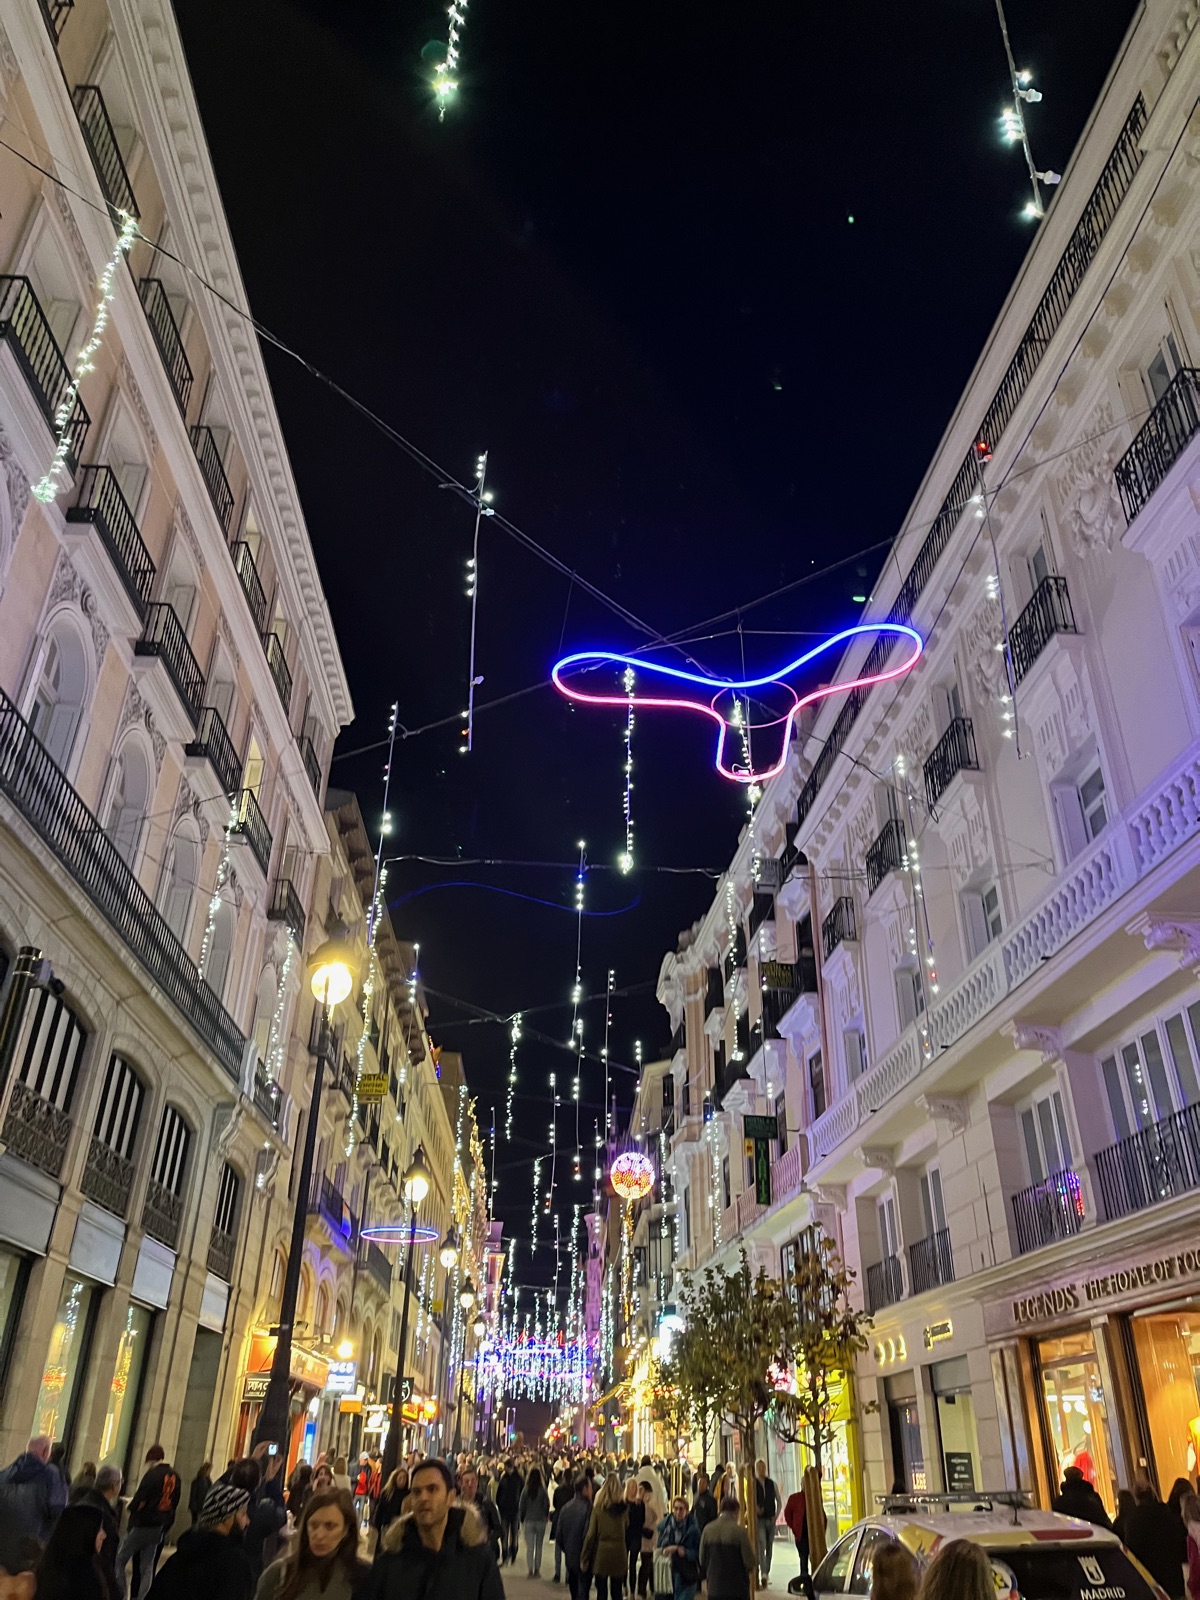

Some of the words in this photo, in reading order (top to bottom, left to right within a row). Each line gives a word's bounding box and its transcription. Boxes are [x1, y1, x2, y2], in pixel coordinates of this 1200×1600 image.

[1012, 1284, 1078, 1323] LEGENDS
[1082, 1277, 1109, 1301] THE
[1109, 1265, 1150, 1295] HOME
[1152, 1259, 1174, 1282] OF
[1080, 1586, 1126, 1600] MADRID
